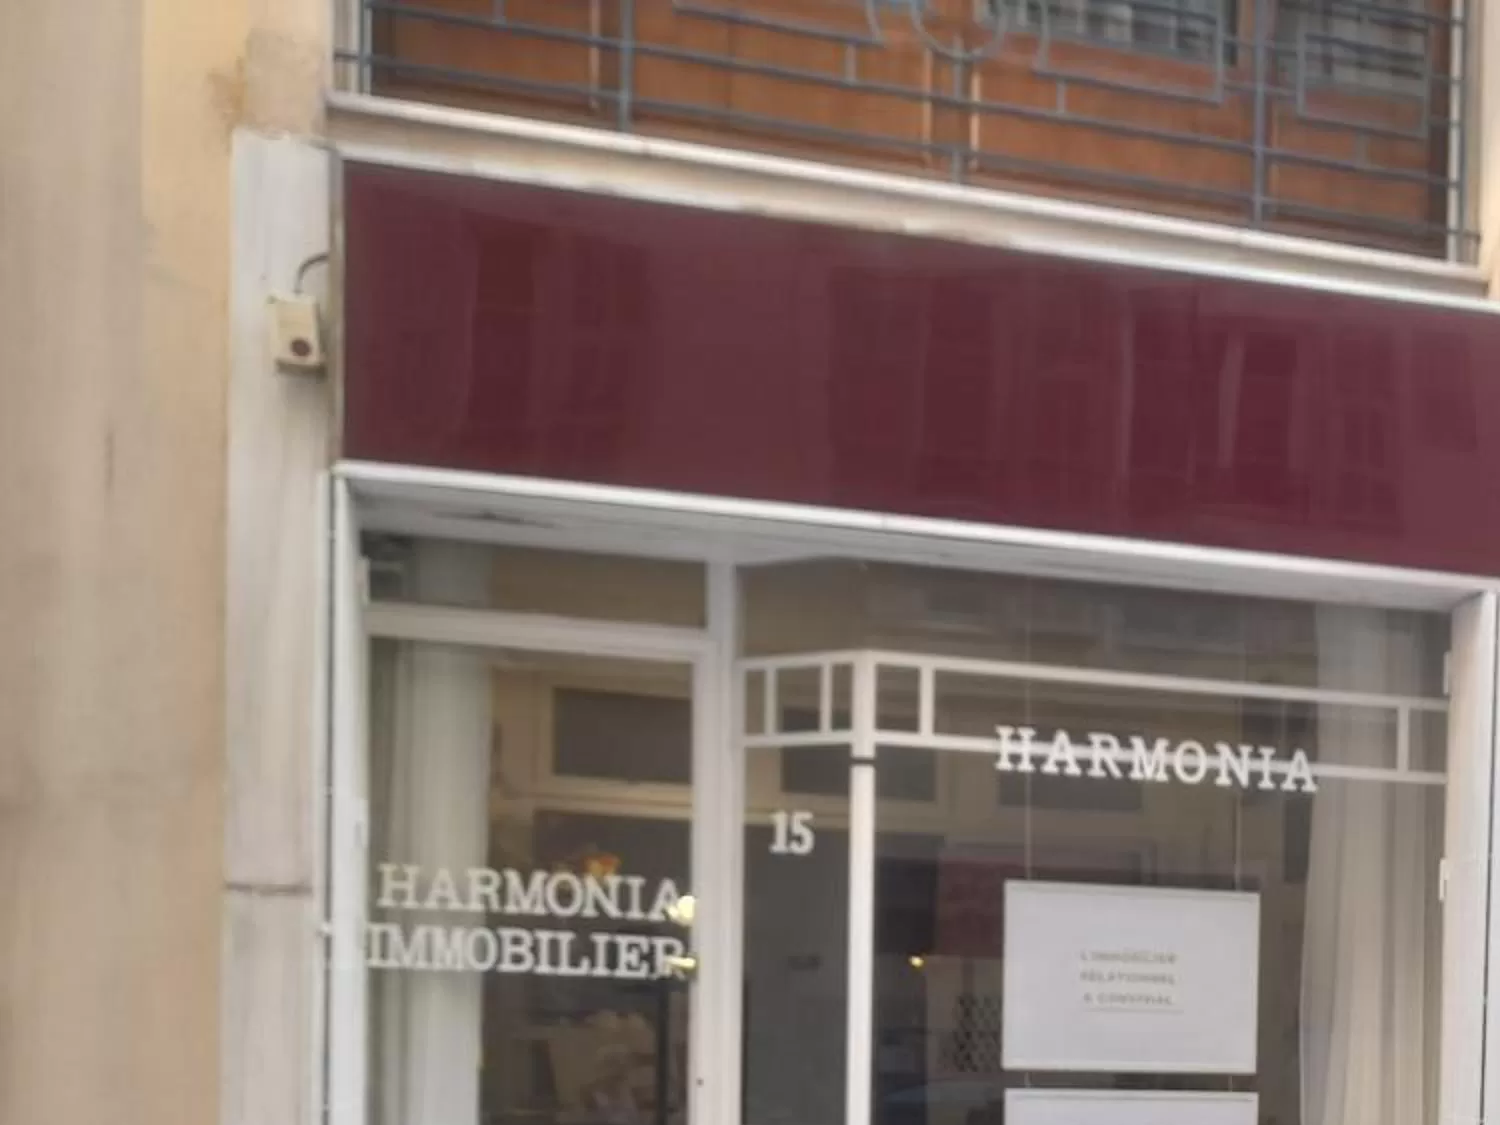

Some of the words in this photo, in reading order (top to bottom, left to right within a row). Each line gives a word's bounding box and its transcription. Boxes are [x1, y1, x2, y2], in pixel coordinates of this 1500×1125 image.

[994, 725, 1319, 793] HARMONIA
[769, 811, 814, 855] 15
[376, 863, 684, 922] HARMONIA
[364, 921, 688, 979] IMMOBILIER
